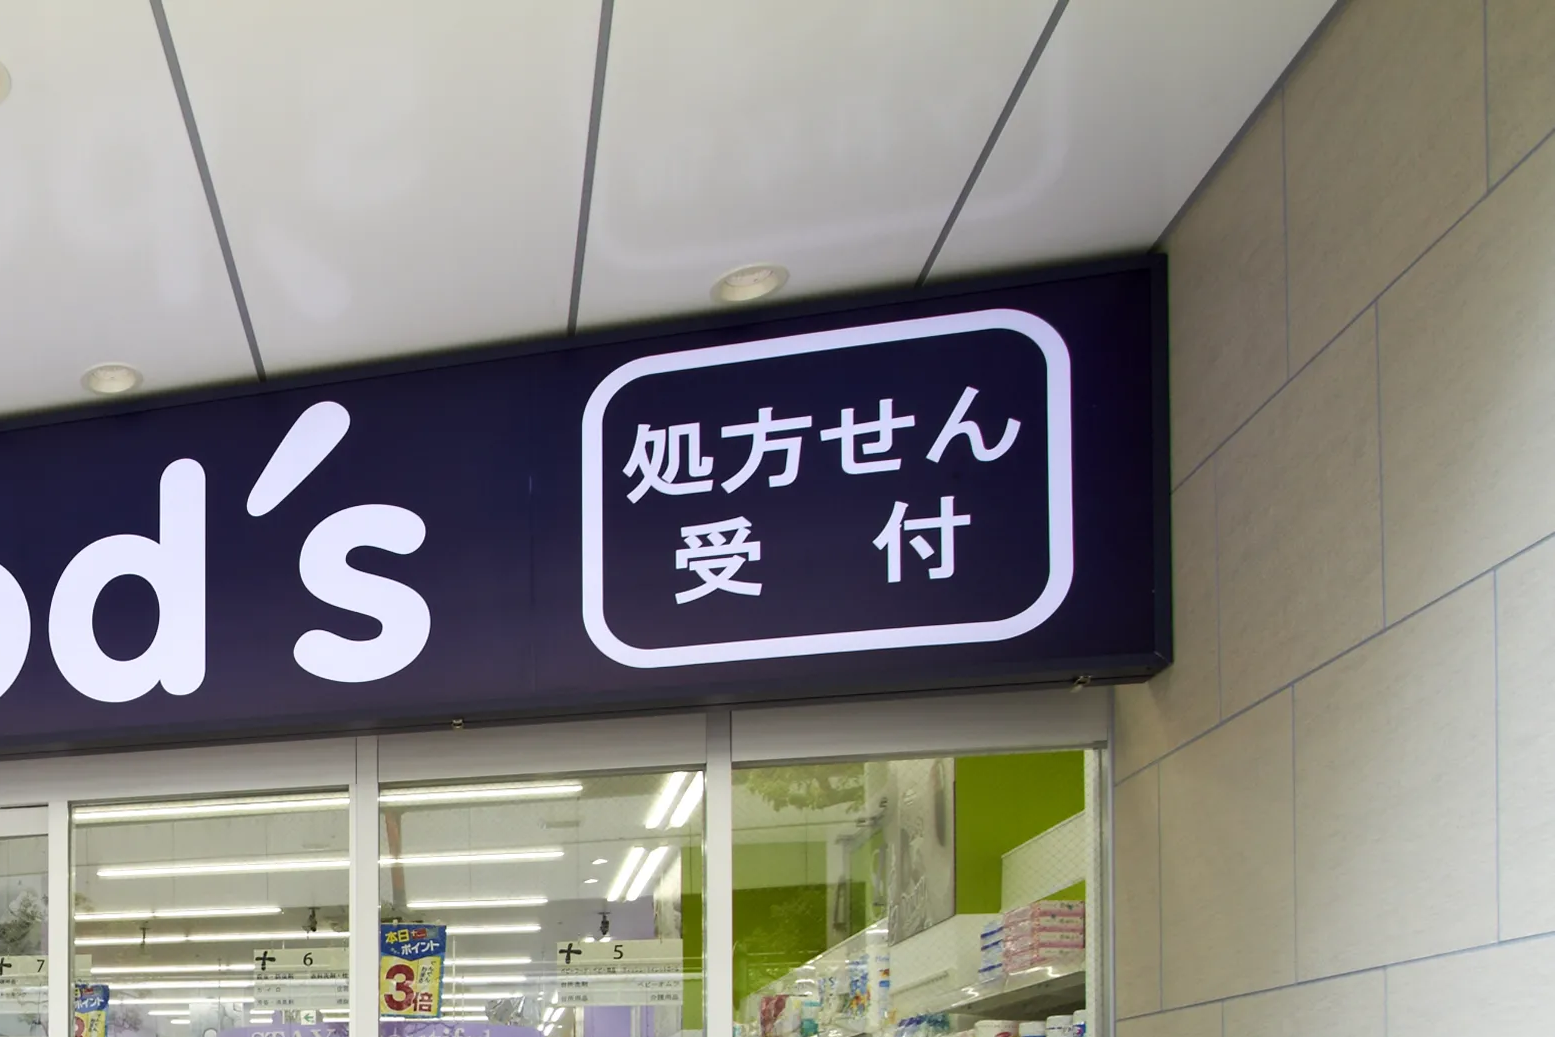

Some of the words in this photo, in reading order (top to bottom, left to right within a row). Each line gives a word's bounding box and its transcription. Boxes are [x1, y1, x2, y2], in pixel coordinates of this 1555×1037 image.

[622, 386, 1021, 504] 処方せん
[385, 929, 410, 944] 本日
[401, 940, 440, 955] ポイント
[613, 945, 623, 959] 5
[37, 959, 45, 973] 7
[303, 952, 313, 966] 6
[384, 964, 433, 1012] 3倍
